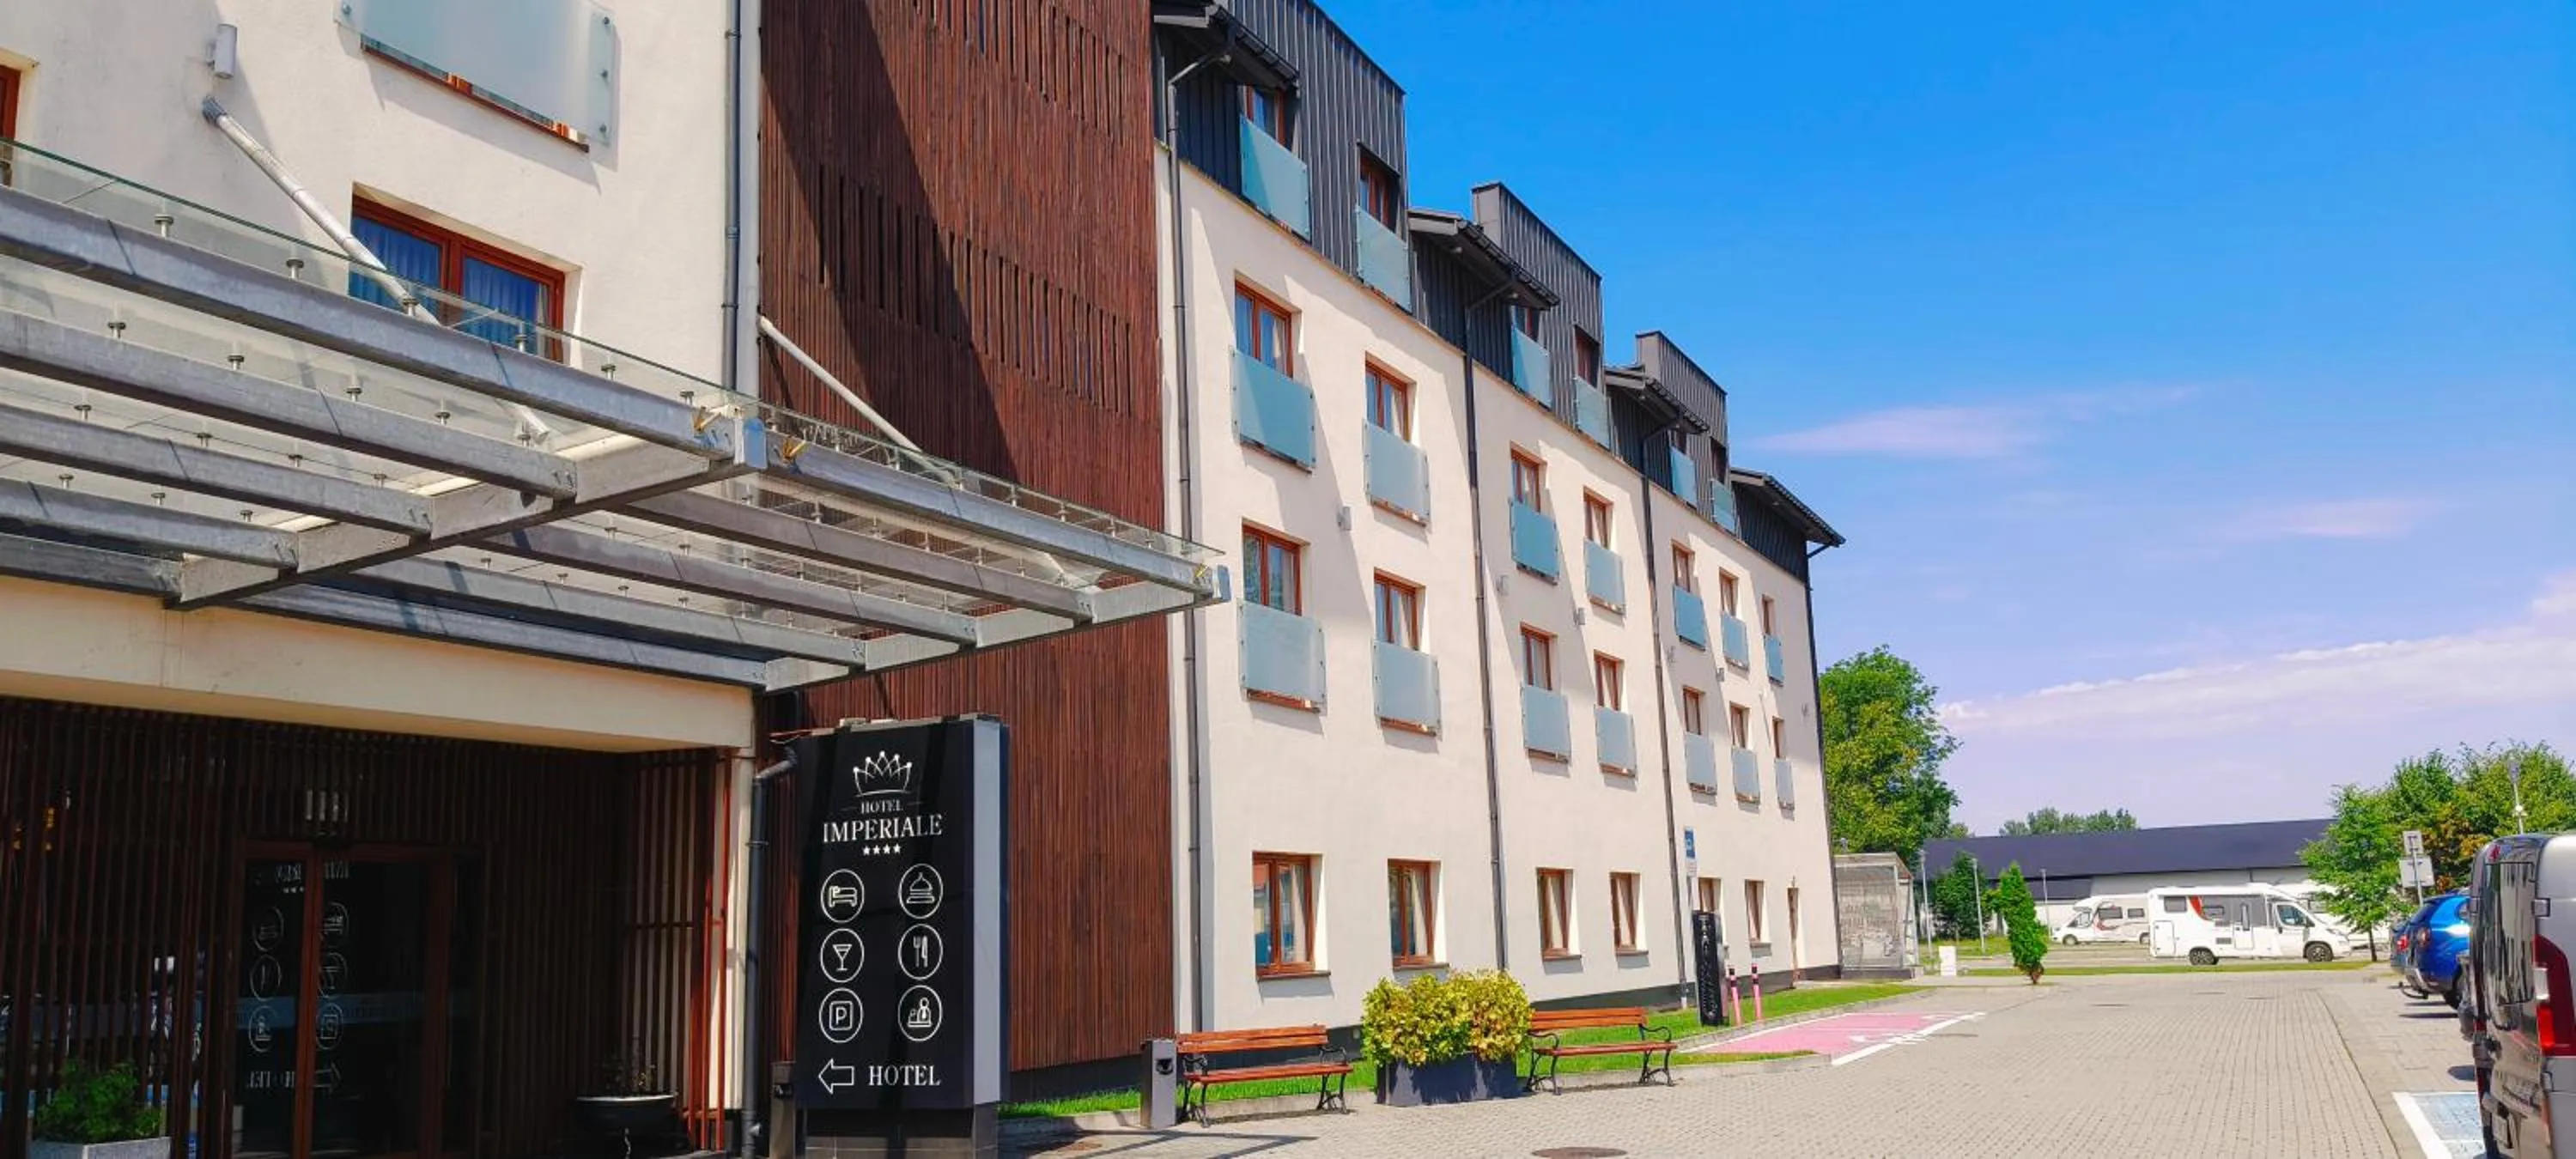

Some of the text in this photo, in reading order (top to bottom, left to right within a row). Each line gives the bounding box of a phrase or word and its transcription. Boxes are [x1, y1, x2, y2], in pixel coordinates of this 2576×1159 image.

[860, 799, 903, 815] HOTEL
[823, 814, 943, 843] IMPERIALE
[835, 1006, 847, 1025] P
[868, 1065, 942, 1086] HOTEL
